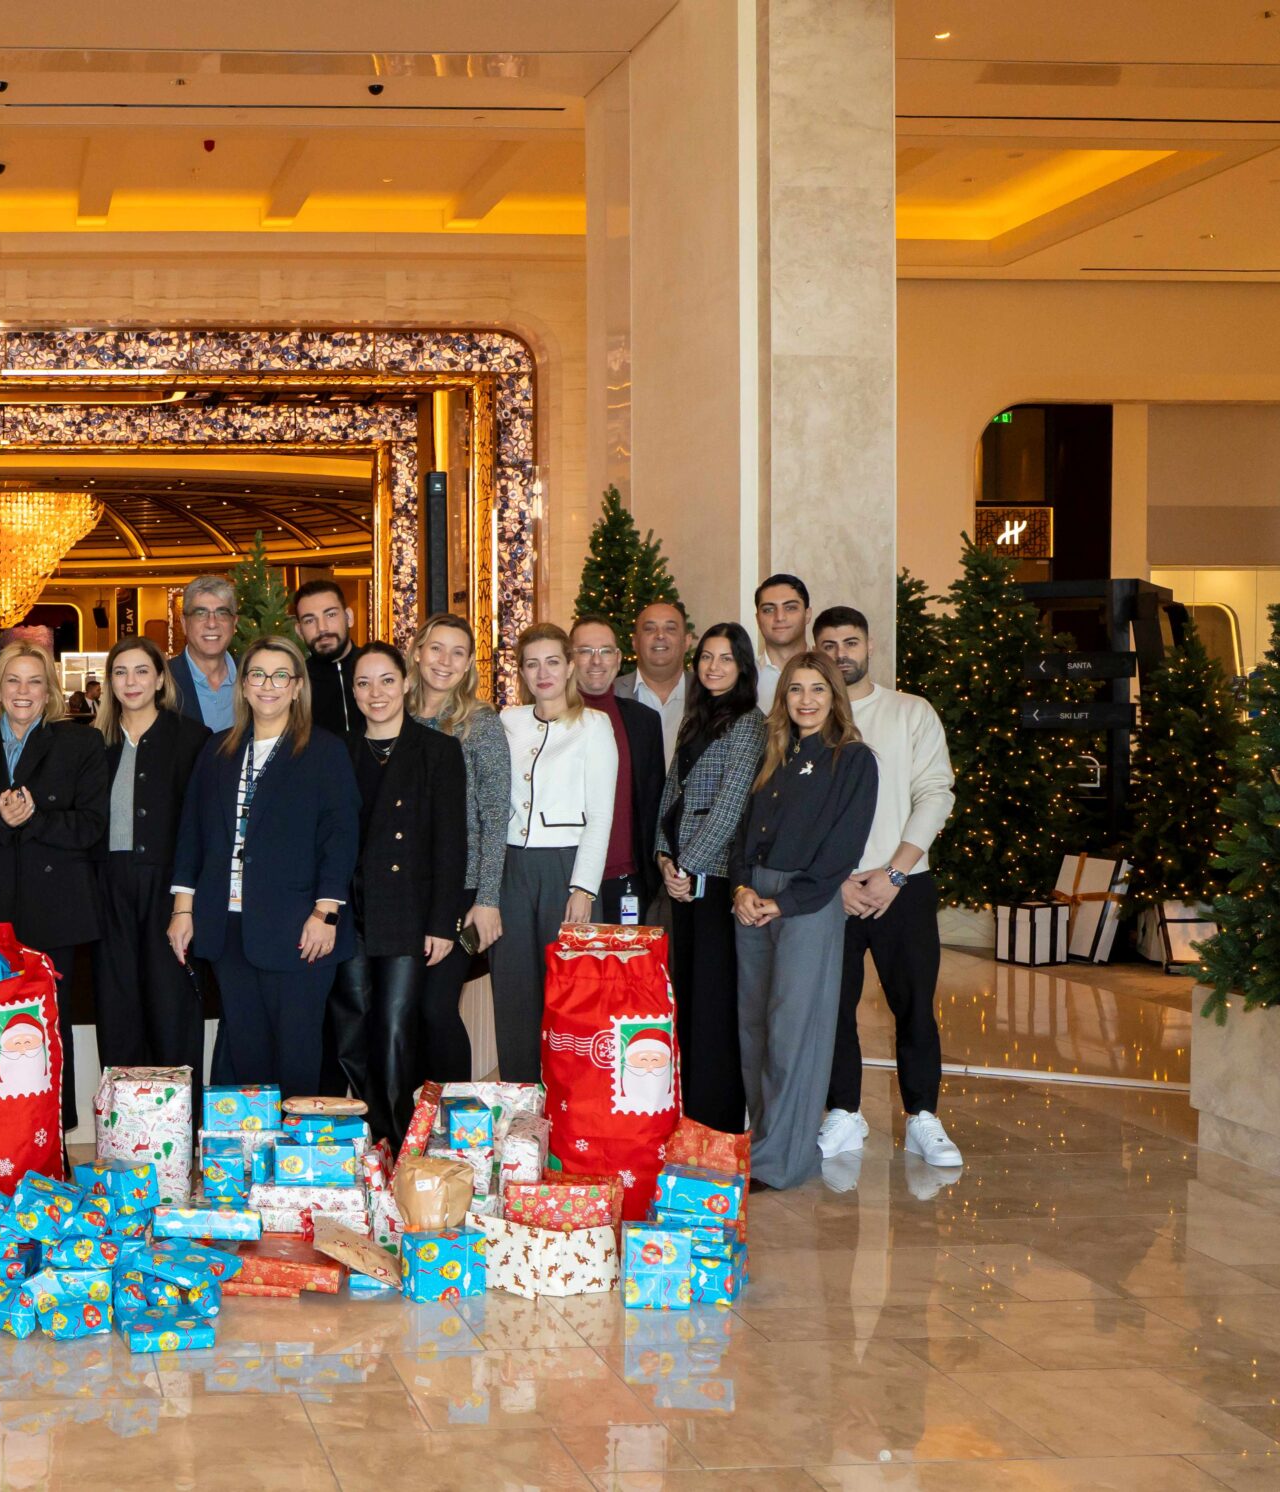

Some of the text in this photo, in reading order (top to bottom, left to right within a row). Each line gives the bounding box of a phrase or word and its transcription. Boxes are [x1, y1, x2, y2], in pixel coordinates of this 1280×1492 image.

[1067, 662, 1092, 670] SANTA
[1059, 712, 1089, 720] SKI LIFT
